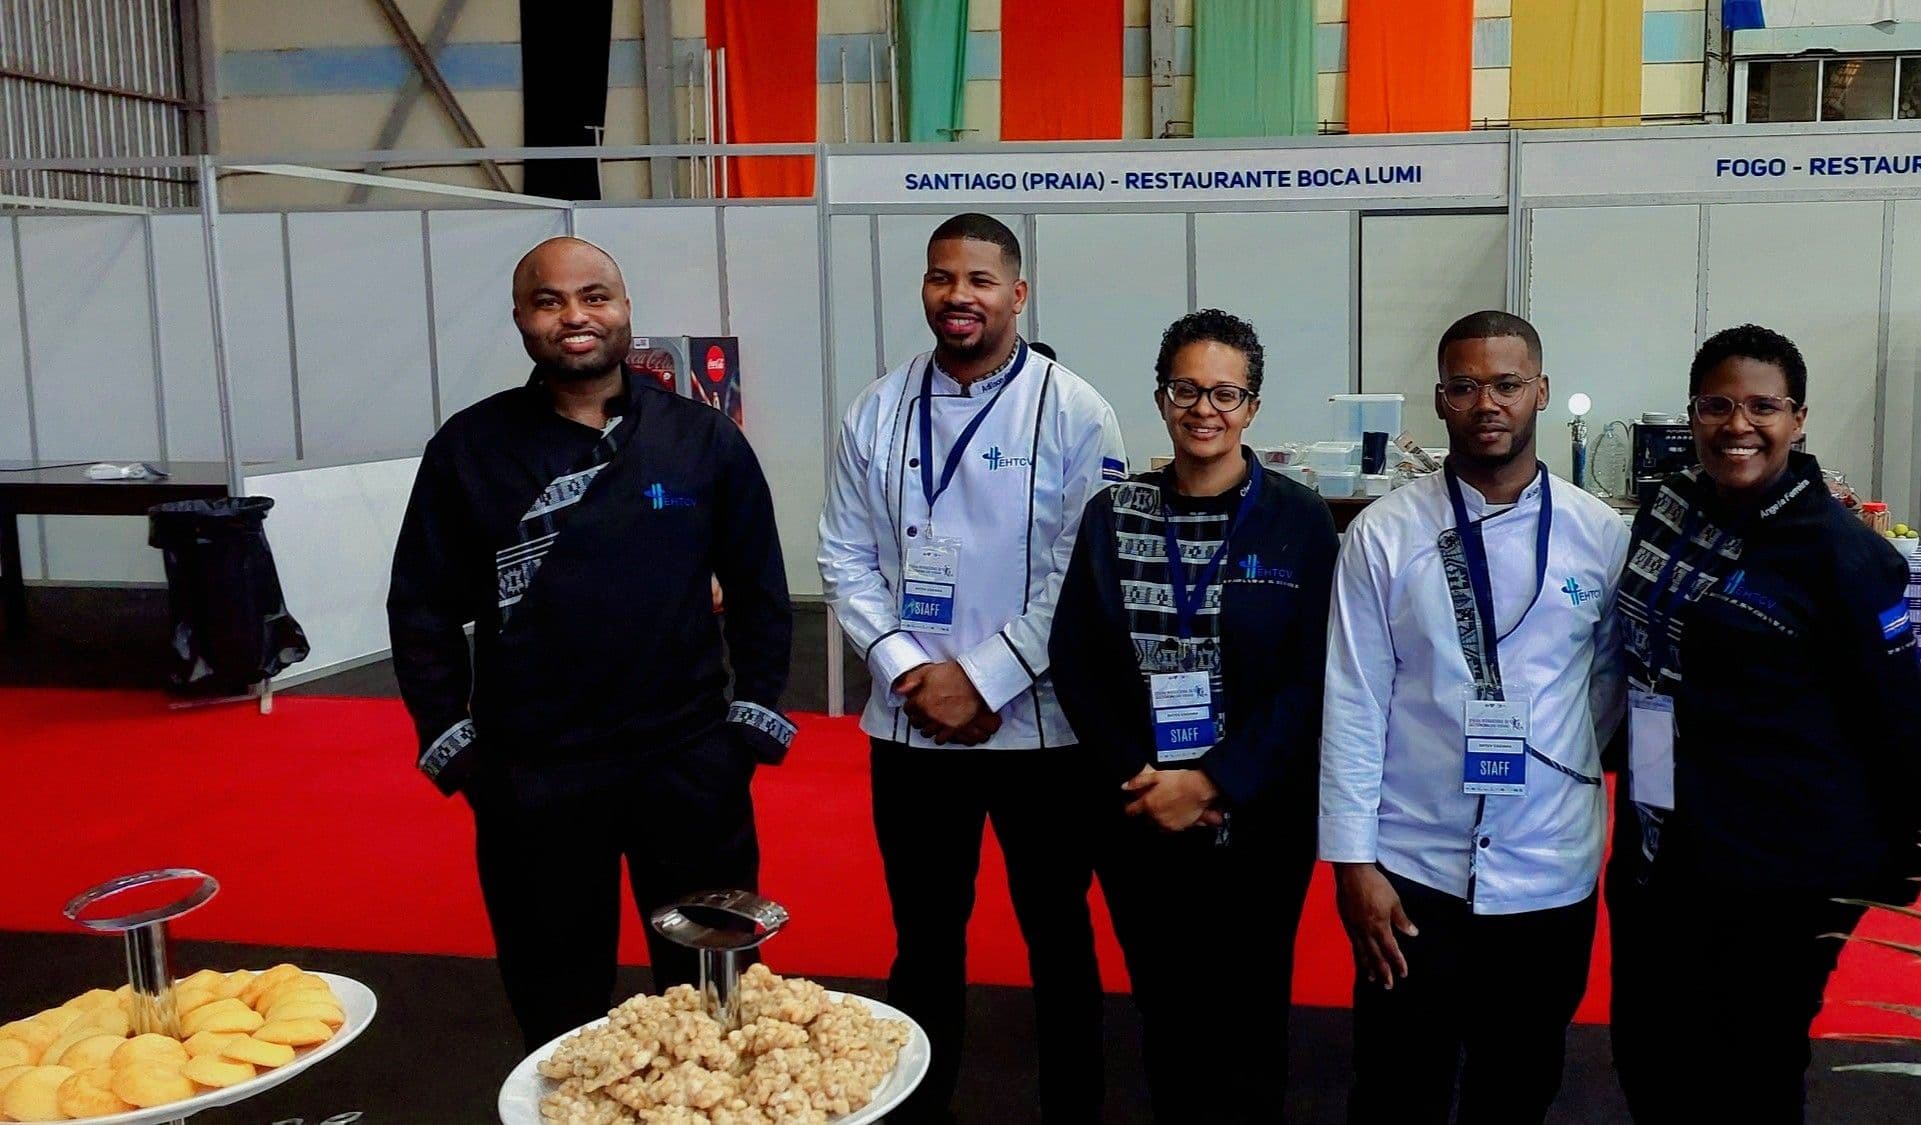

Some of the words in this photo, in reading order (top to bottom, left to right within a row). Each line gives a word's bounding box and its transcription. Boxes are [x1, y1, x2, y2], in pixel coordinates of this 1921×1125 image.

[1716, 158, 1786, 177] FOGO
[1809, 155, 1921, 176] RESTAUR
[904, 172, 1017, 191] SANTIAGO
[1021, 171, 1105, 192] (PRAIA)
[1125, 170, 1292, 190] RESTAURANTE
[1297, 168, 1361, 188] BOCA
[1365, 165, 1422, 185] LUMI
[1578, 589, 1601, 602] EHTC
[914, 601, 940, 617] STAFF
[1170, 727, 1199, 743] STAFF
[1480, 760, 1510, 776] STAFF
